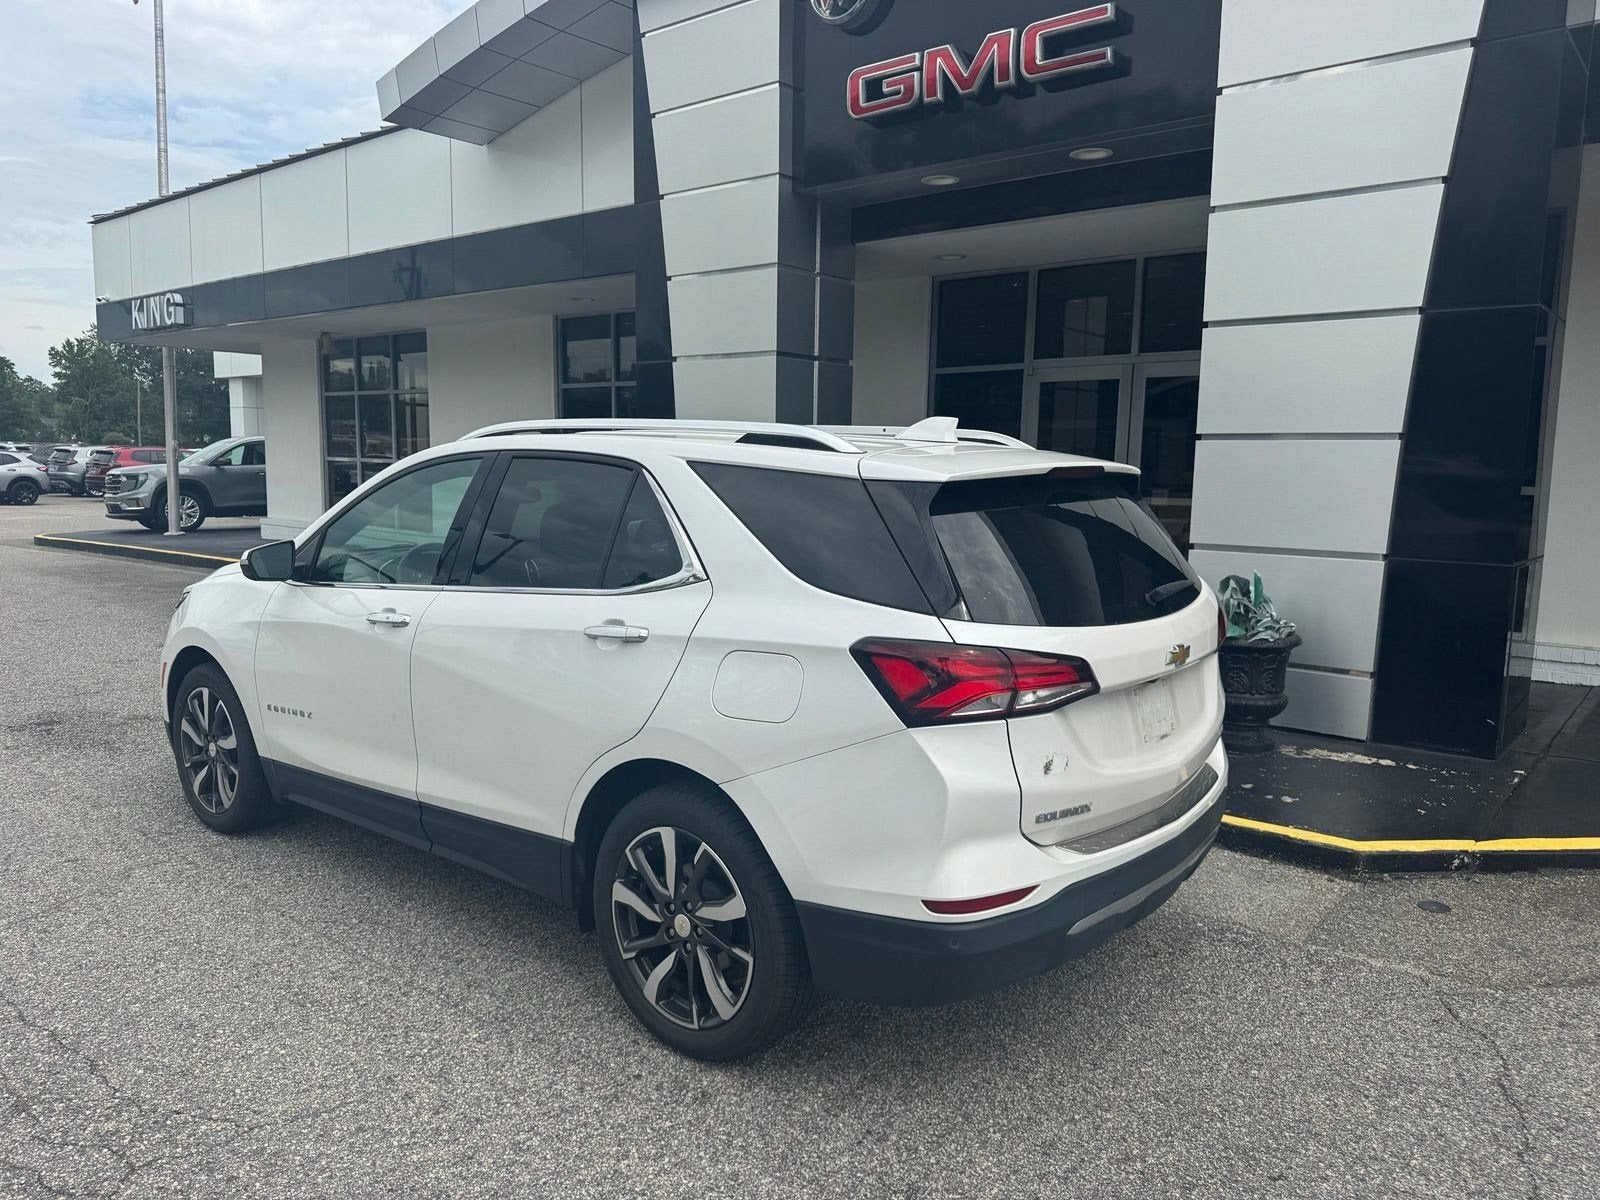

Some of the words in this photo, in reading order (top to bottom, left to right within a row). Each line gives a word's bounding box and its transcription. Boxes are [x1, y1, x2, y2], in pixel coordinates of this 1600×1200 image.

[847, 2, 1115, 119] GMC
[131, 292, 177, 330] KING
[266, 703, 313, 720] EQUINOX
[1034, 801, 1093, 824] EQUINOX
